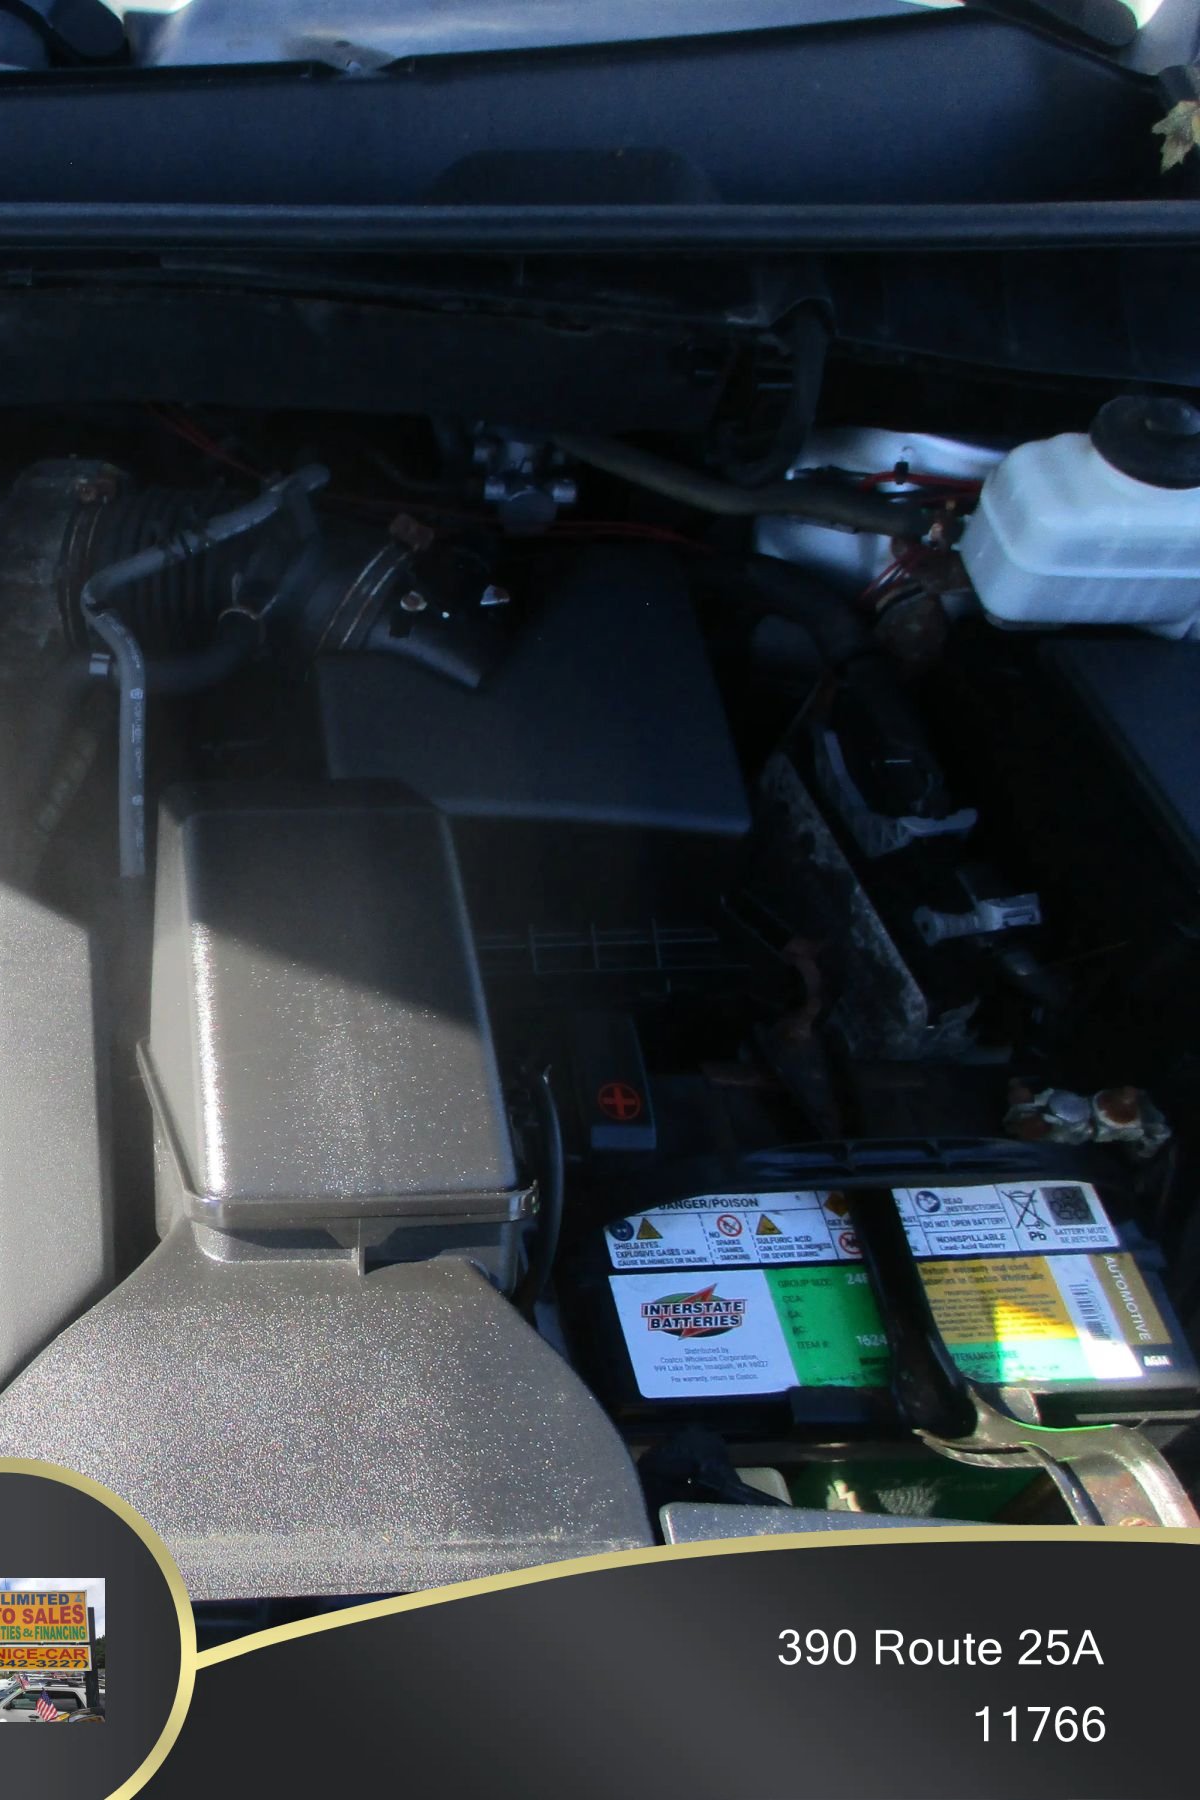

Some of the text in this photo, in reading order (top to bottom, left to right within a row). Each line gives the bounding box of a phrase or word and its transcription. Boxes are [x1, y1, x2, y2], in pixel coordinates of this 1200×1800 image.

[1028, 1231, 1047, 1241] Pb
[1054, 1228, 1084, 1236] BATTERY
[756, 1236, 792, 1244] SULFURIC
[936, 1233, 1006, 1243] NONSPILLABLE
[978, 1242, 1006, 1250] Battery
[616, 1250, 655, 1258] EXPLOSIVE
[656, 1249, 680, 1257] GASES
[778, 1279, 808, 1287] GROUP
[1103, 1255, 1152, 1342] AUTOMOTIVE
[644, 1302, 743, 1315] INTERSTATE
[650, 1315, 740, 1329] BATTERIES
[721, 1347, 730, 1355] by
[1144, 1355, 1170, 1367] AGM
[668, 1364, 683, 1372] Lake
